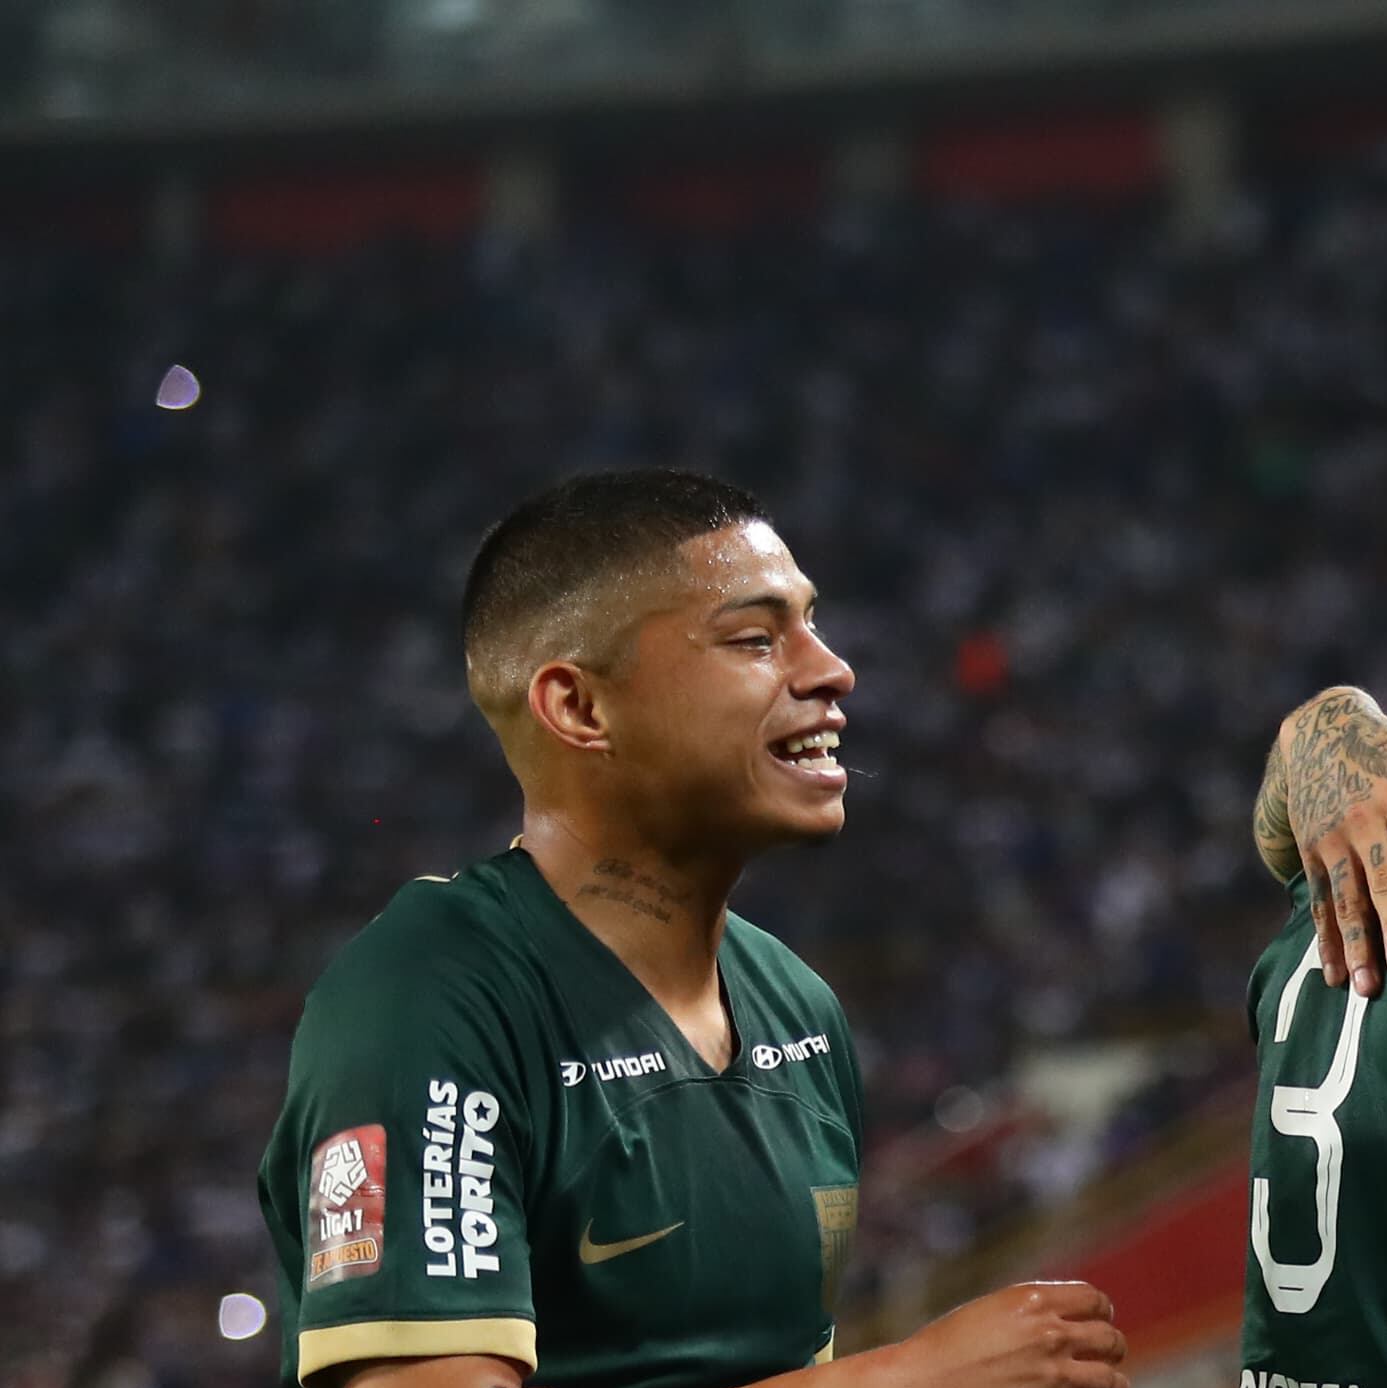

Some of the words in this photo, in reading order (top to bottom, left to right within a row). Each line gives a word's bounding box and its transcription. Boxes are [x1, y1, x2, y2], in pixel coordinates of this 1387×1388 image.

[423, 1079, 459, 1277] LOTERÍAS
[458, 1090, 501, 1279] TORITO
[1252, 933, 1369, 1314] 3
[320, 1207, 353, 1242] LIGA
